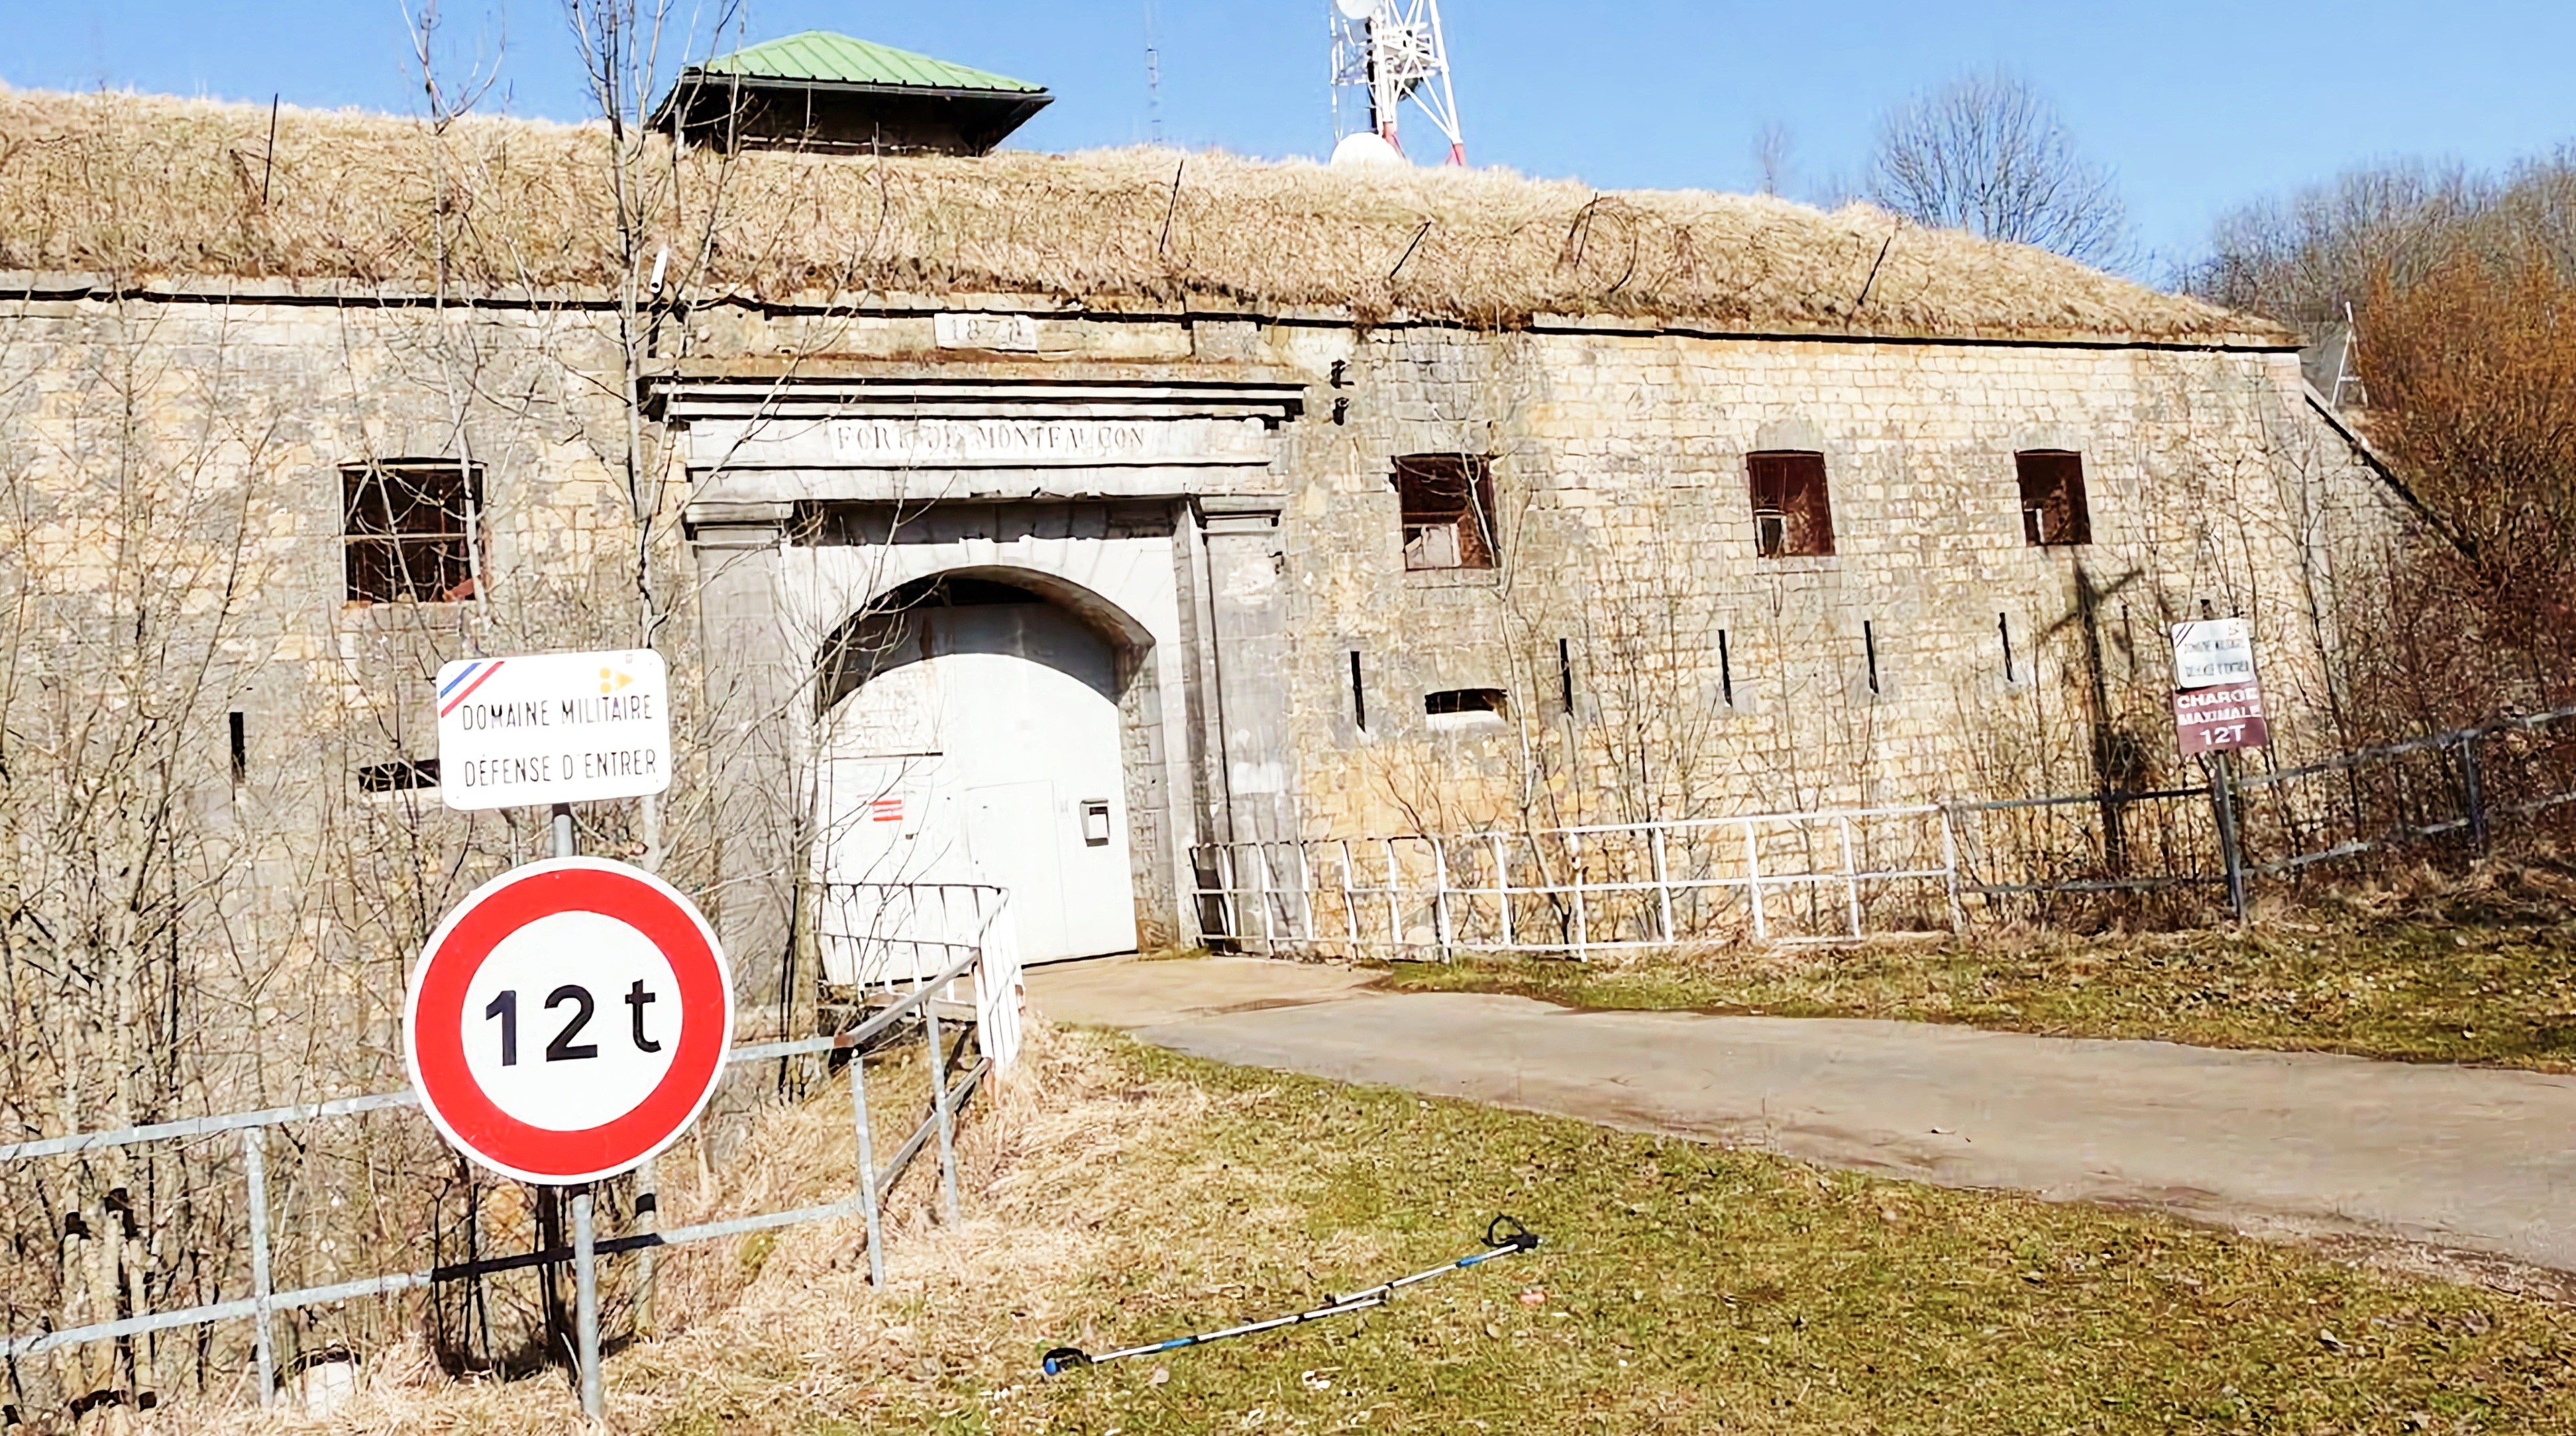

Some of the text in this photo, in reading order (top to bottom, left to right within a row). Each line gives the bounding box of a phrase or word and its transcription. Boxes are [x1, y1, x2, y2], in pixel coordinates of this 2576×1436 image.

[2177, 688, 2259, 709] CHARGE
[462, 694, 653, 730] DOMAINE MILITAIRE
[2177, 704, 2262, 726] MAXIMALE
[2200, 724, 2245, 745] 12T
[464, 753, 551, 787] DÉFENSE
